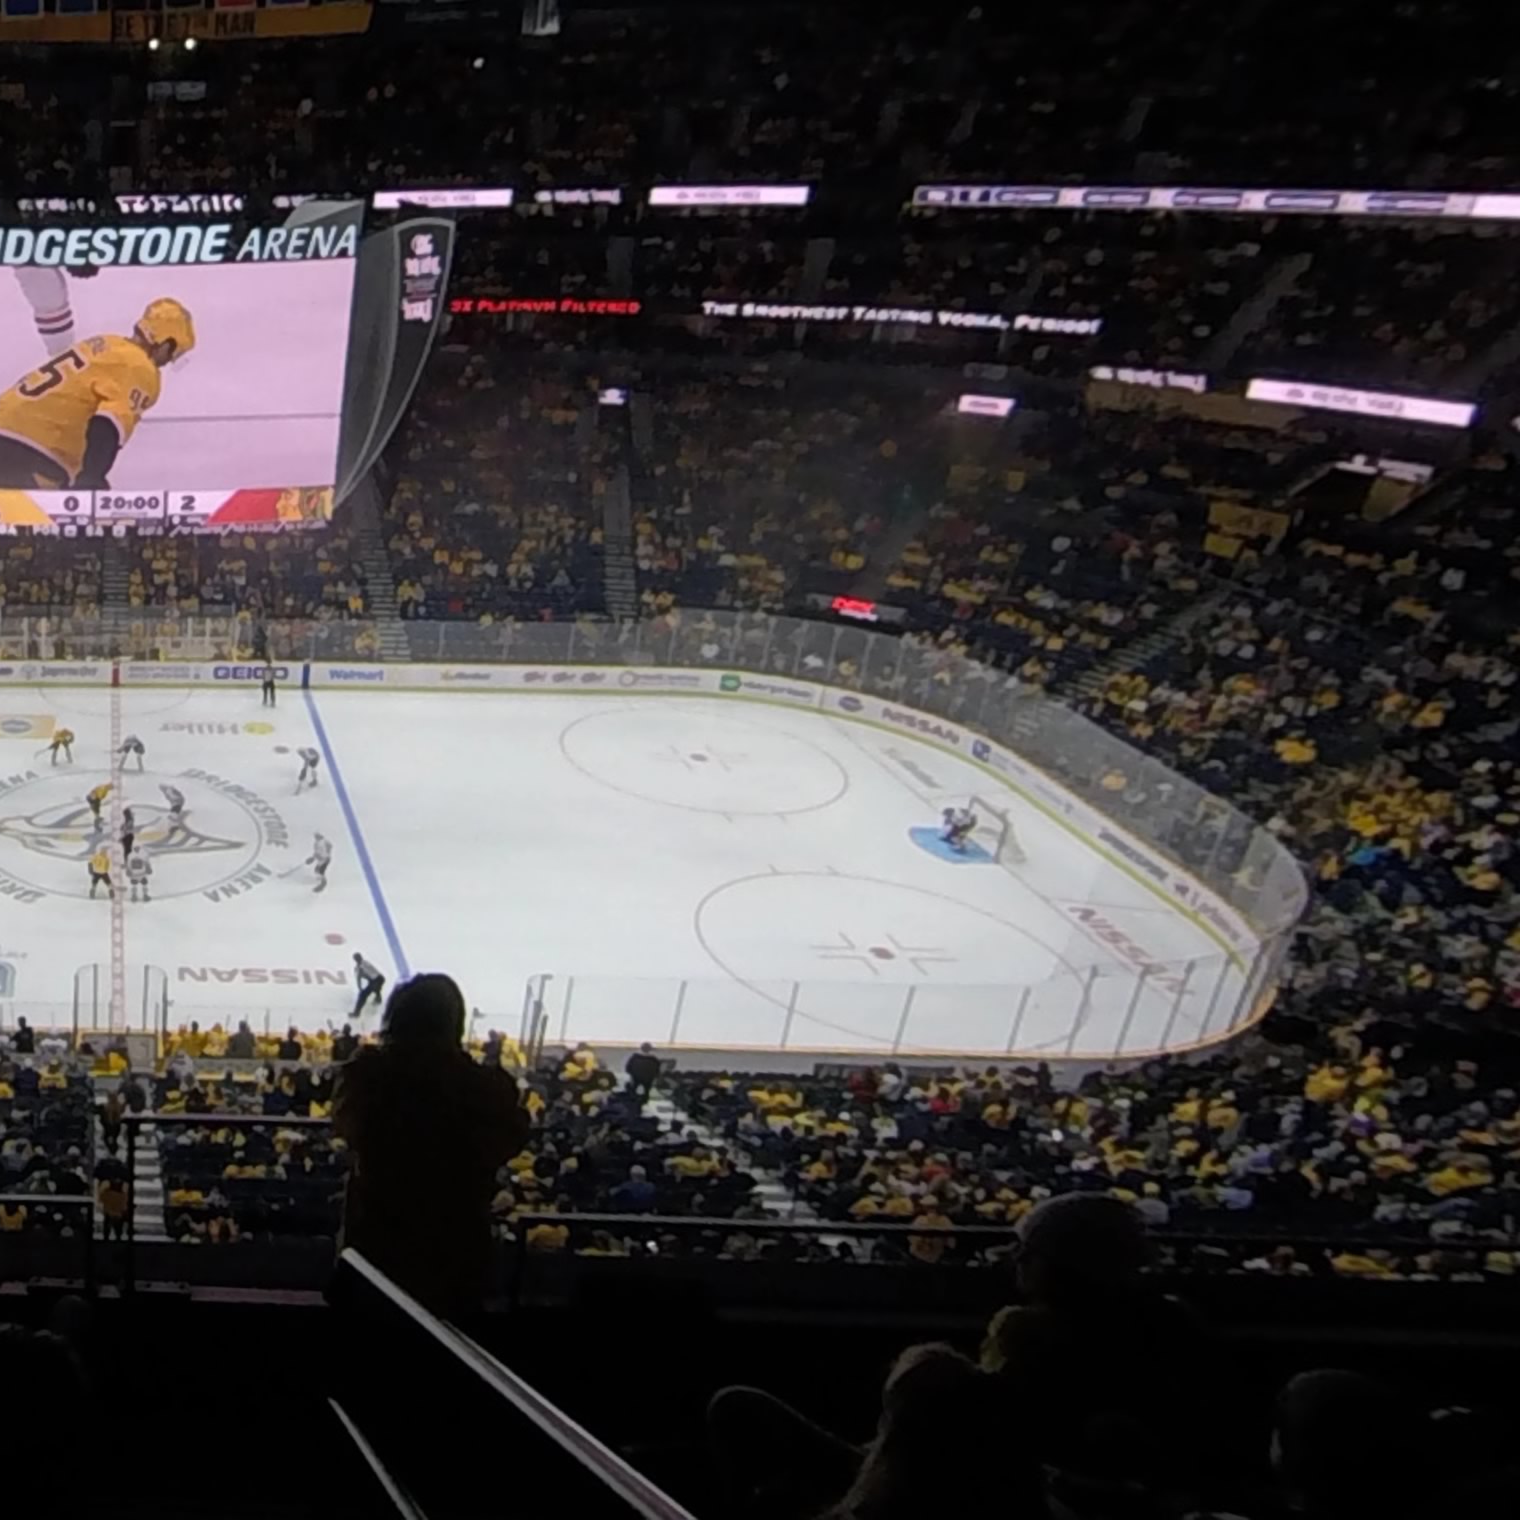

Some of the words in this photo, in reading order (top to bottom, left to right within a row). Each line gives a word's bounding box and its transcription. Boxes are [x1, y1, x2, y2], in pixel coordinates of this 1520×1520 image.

[235, 224, 357, 263] ARENA
[478, 300, 556, 313] PLATINUM
[560, 300, 641, 315] FILTERED
[702, 301, 737, 316] THE
[741, 302, 849, 320] SMOOTHEST
[852, 306, 933, 325] TASTING
[63, 495, 80, 513] 0
[99, 496, 160, 510] 20:00
[180, 495, 196, 511] 2
[212, 665, 289, 680] GEICO
[329, 669, 384, 681] Walmart
[881, 706, 960, 746] NISSAN
[180, 768, 290, 849] BRIDGESTONE
[202, 862, 273, 904] ARENA
[177, 966, 348, 986] NISSAN
